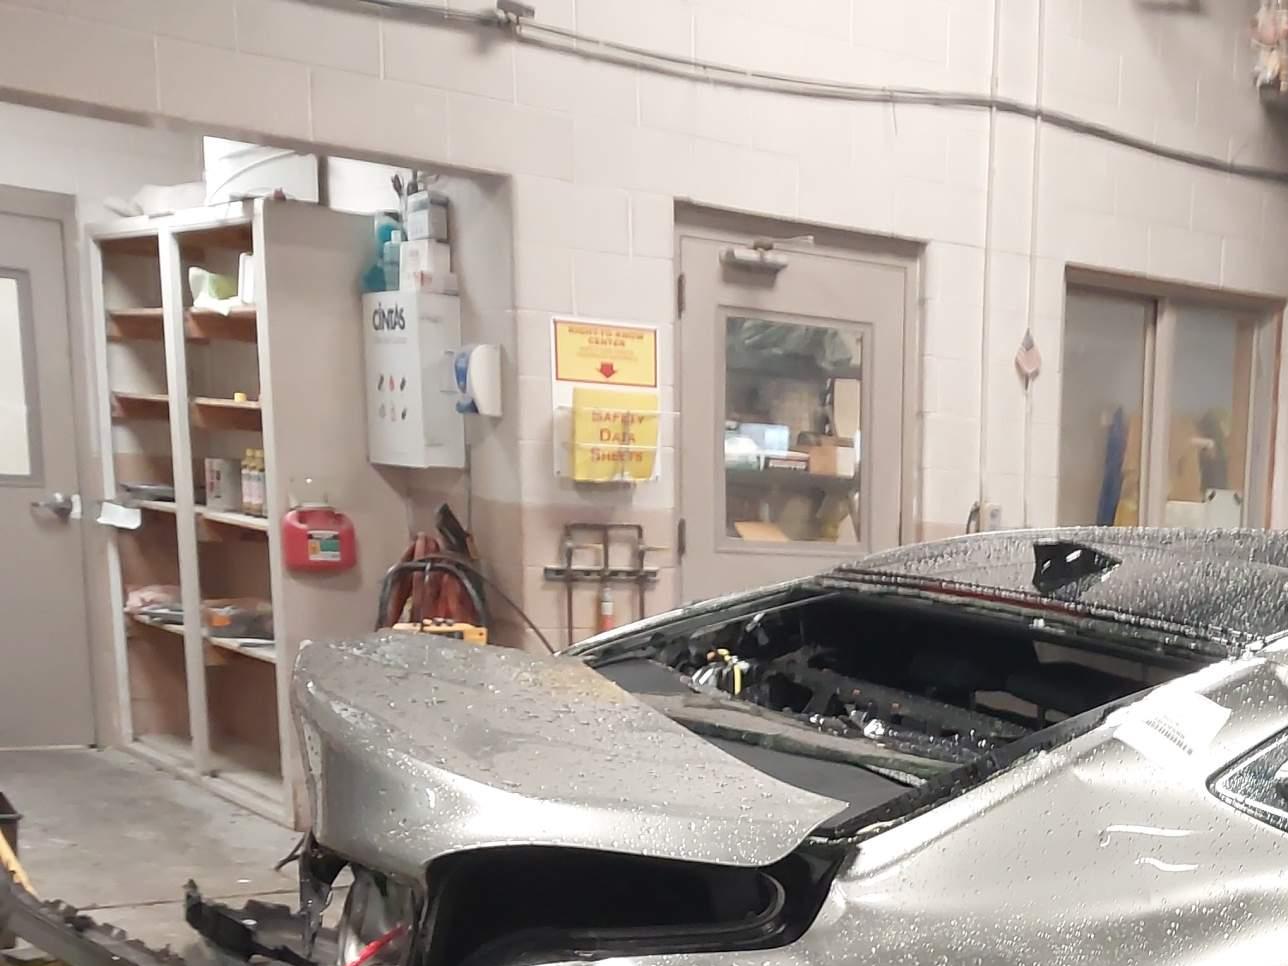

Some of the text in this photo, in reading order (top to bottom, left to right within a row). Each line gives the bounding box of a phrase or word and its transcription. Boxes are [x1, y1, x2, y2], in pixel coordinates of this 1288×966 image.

[591, 411, 644, 424] SAFETY
[600, 428, 637, 443] DATA
[591, 447, 643, 462] SHEETS
